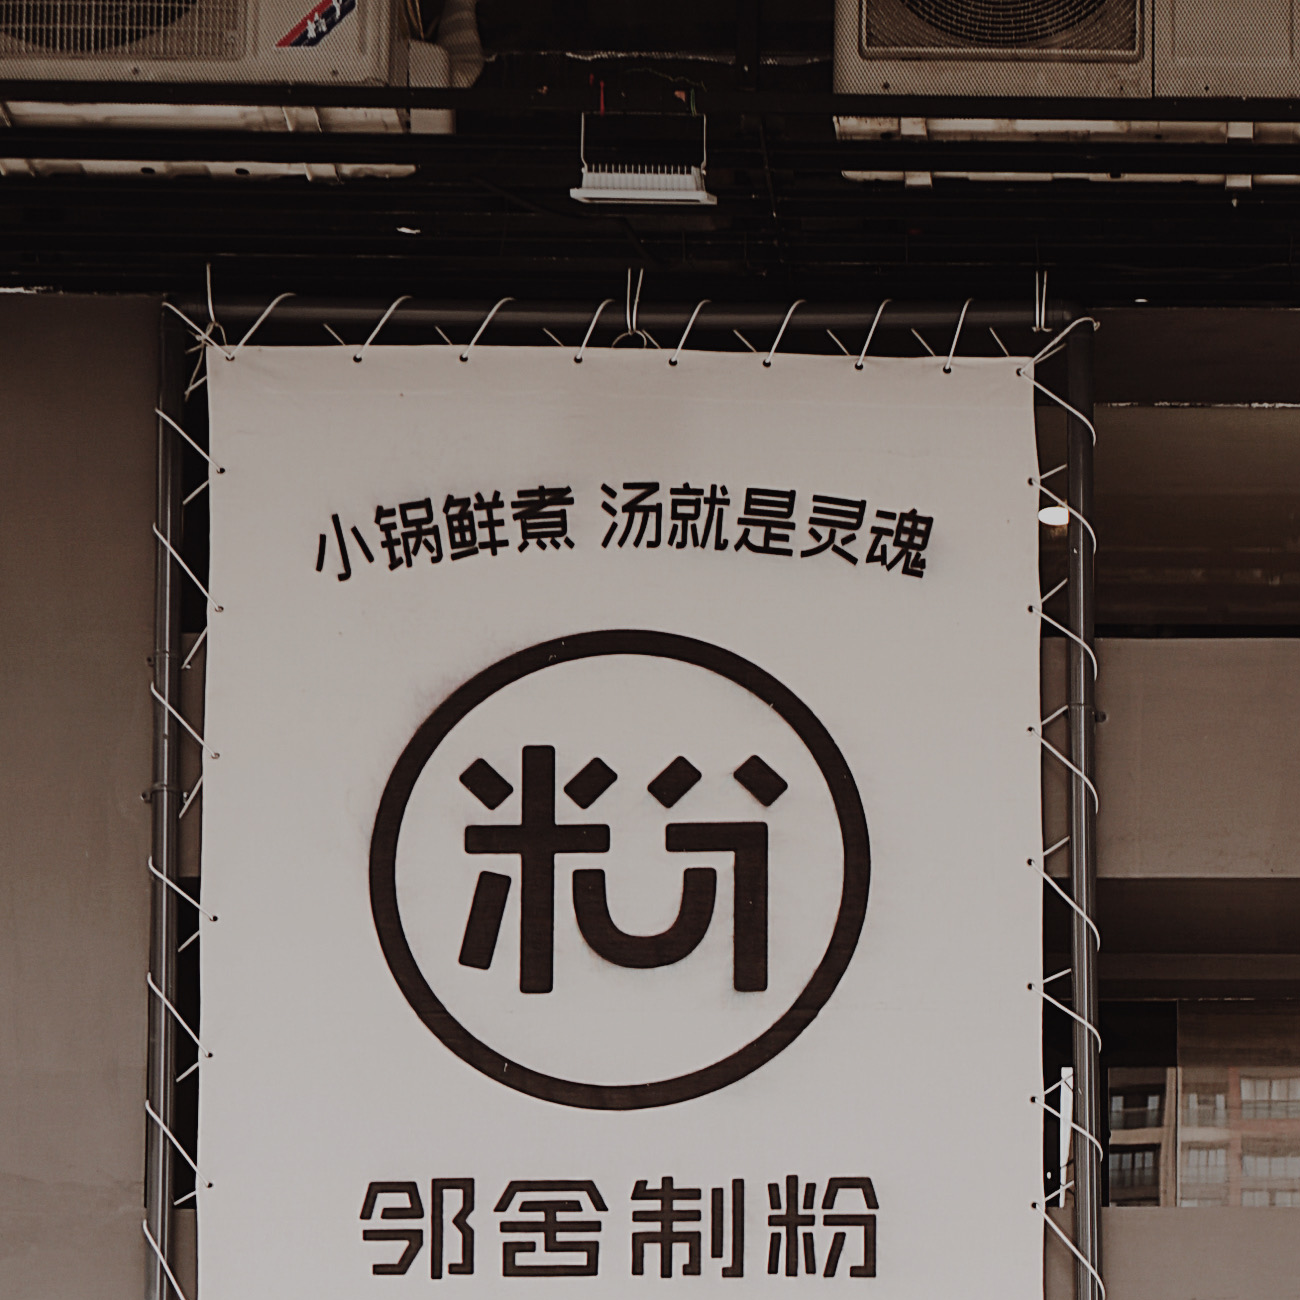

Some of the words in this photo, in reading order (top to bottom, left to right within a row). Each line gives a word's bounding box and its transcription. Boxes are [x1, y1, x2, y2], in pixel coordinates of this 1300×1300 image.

[315, 485, 576, 583] 小锅鲜煮
[600, 481, 935, 580] 汤就是灵魂
[360, 1175, 881, 1281] 邻舍制粉
